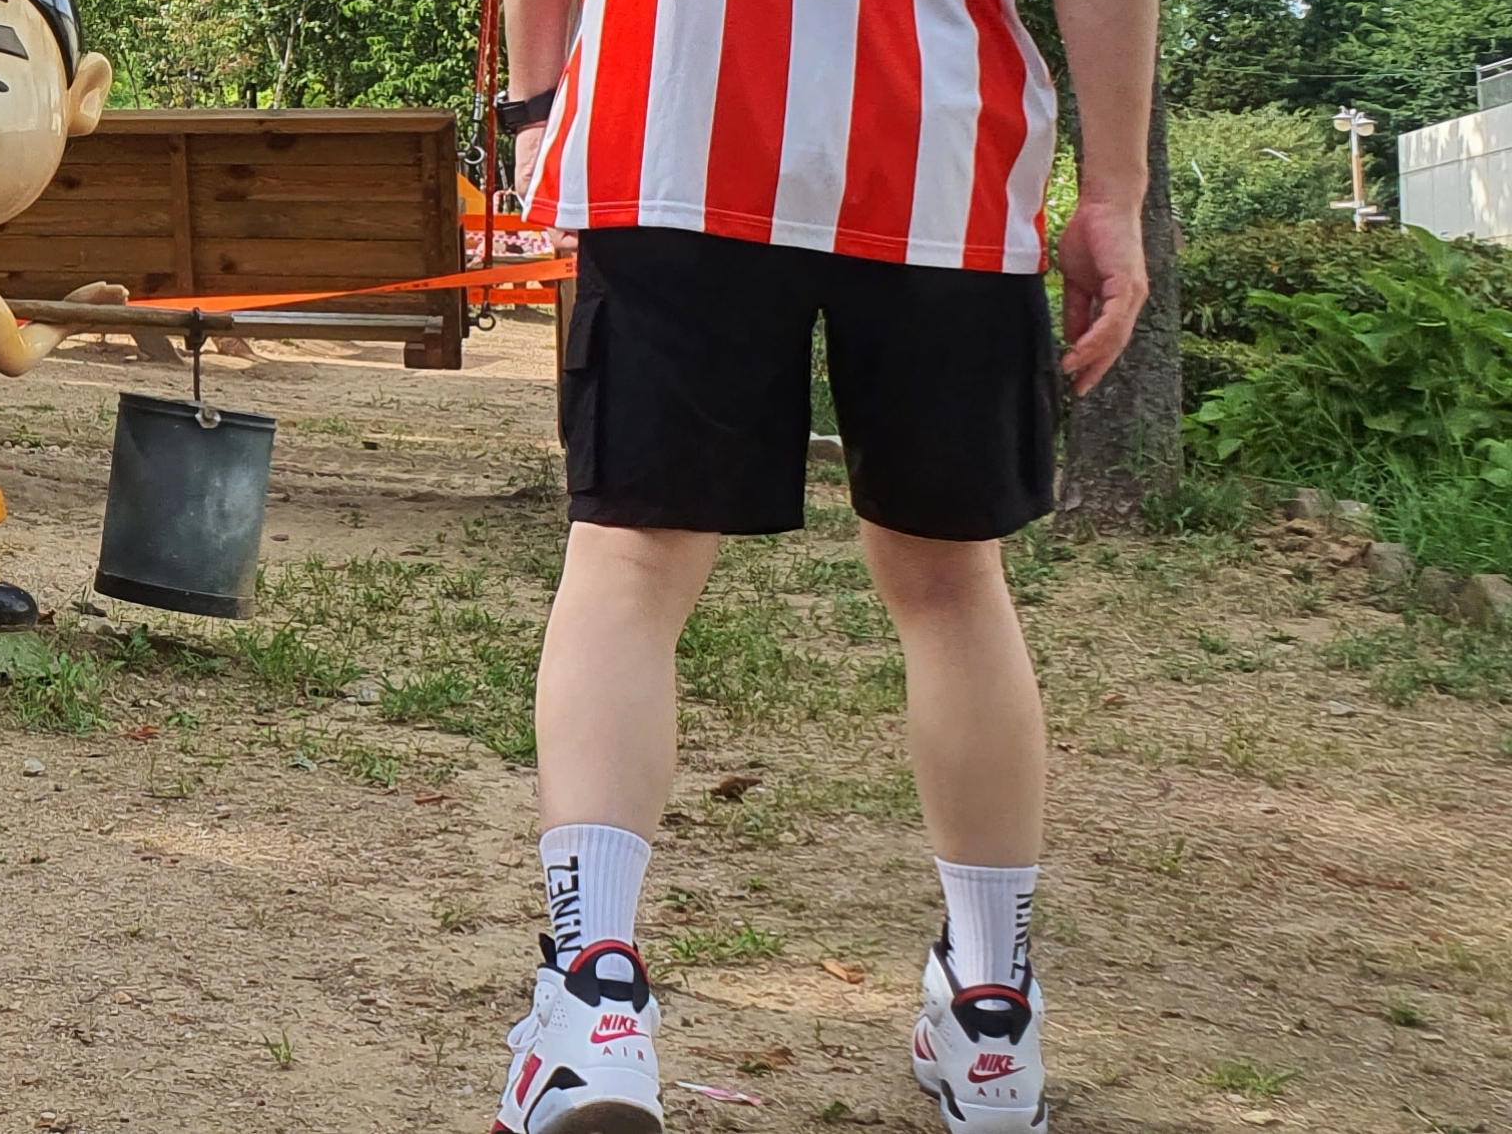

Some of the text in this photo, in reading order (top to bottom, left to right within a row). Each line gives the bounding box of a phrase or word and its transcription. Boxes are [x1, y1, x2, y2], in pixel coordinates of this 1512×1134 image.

[598, 1014, 638, 1034] NIKE
[602, 1045, 645, 1062] AIR
[974, 1053, 1015, 1073] NIKE
[976, 1086, 1018, 1100] AIR
